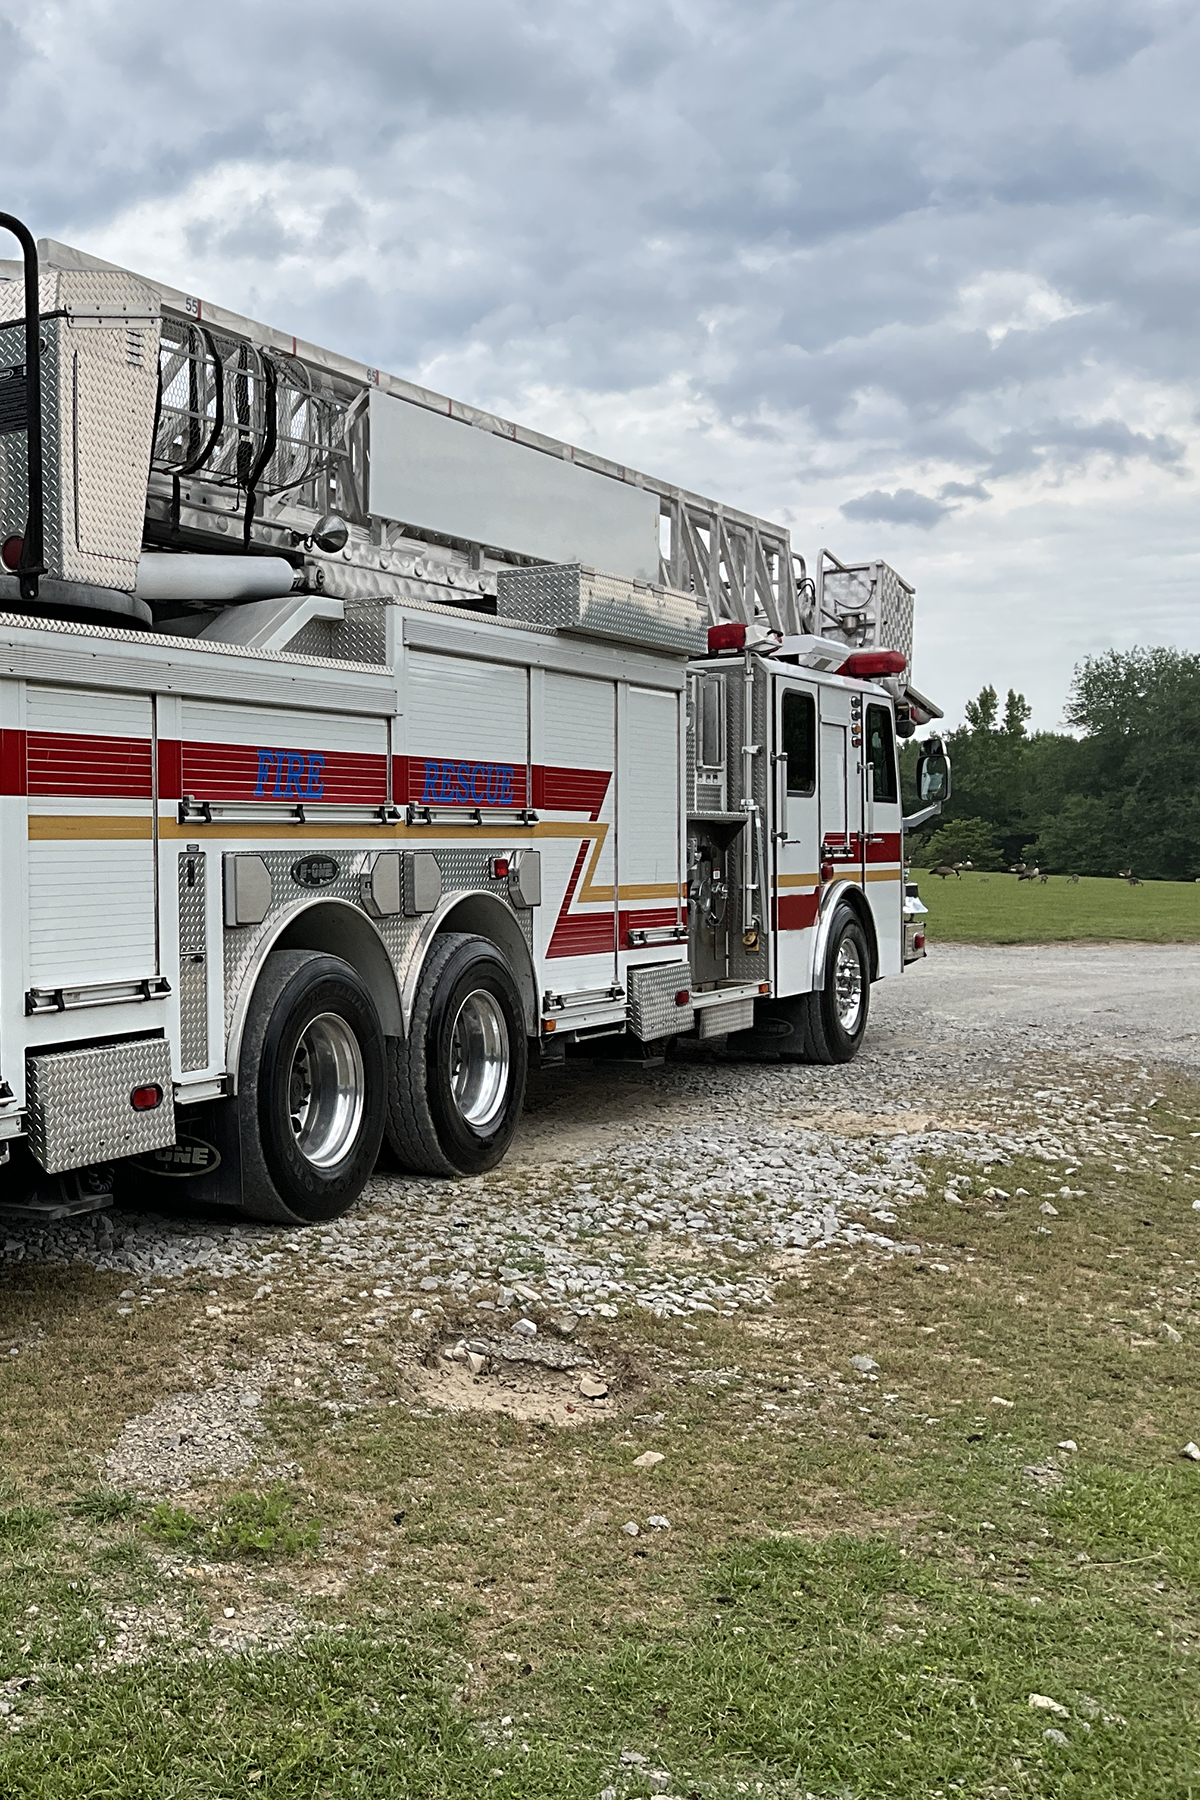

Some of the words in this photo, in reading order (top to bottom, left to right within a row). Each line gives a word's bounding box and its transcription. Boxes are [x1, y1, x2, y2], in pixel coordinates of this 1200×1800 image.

[185, 297, 198, 314] 55
[366, 368, 377, 383] 65
[253, 749, 325, 799] FIRE
[421, 760, 514, 804] RESCUE
[300, 862, 334, 879] E-ONE
[135, 1145, 209, 1165] ONE
